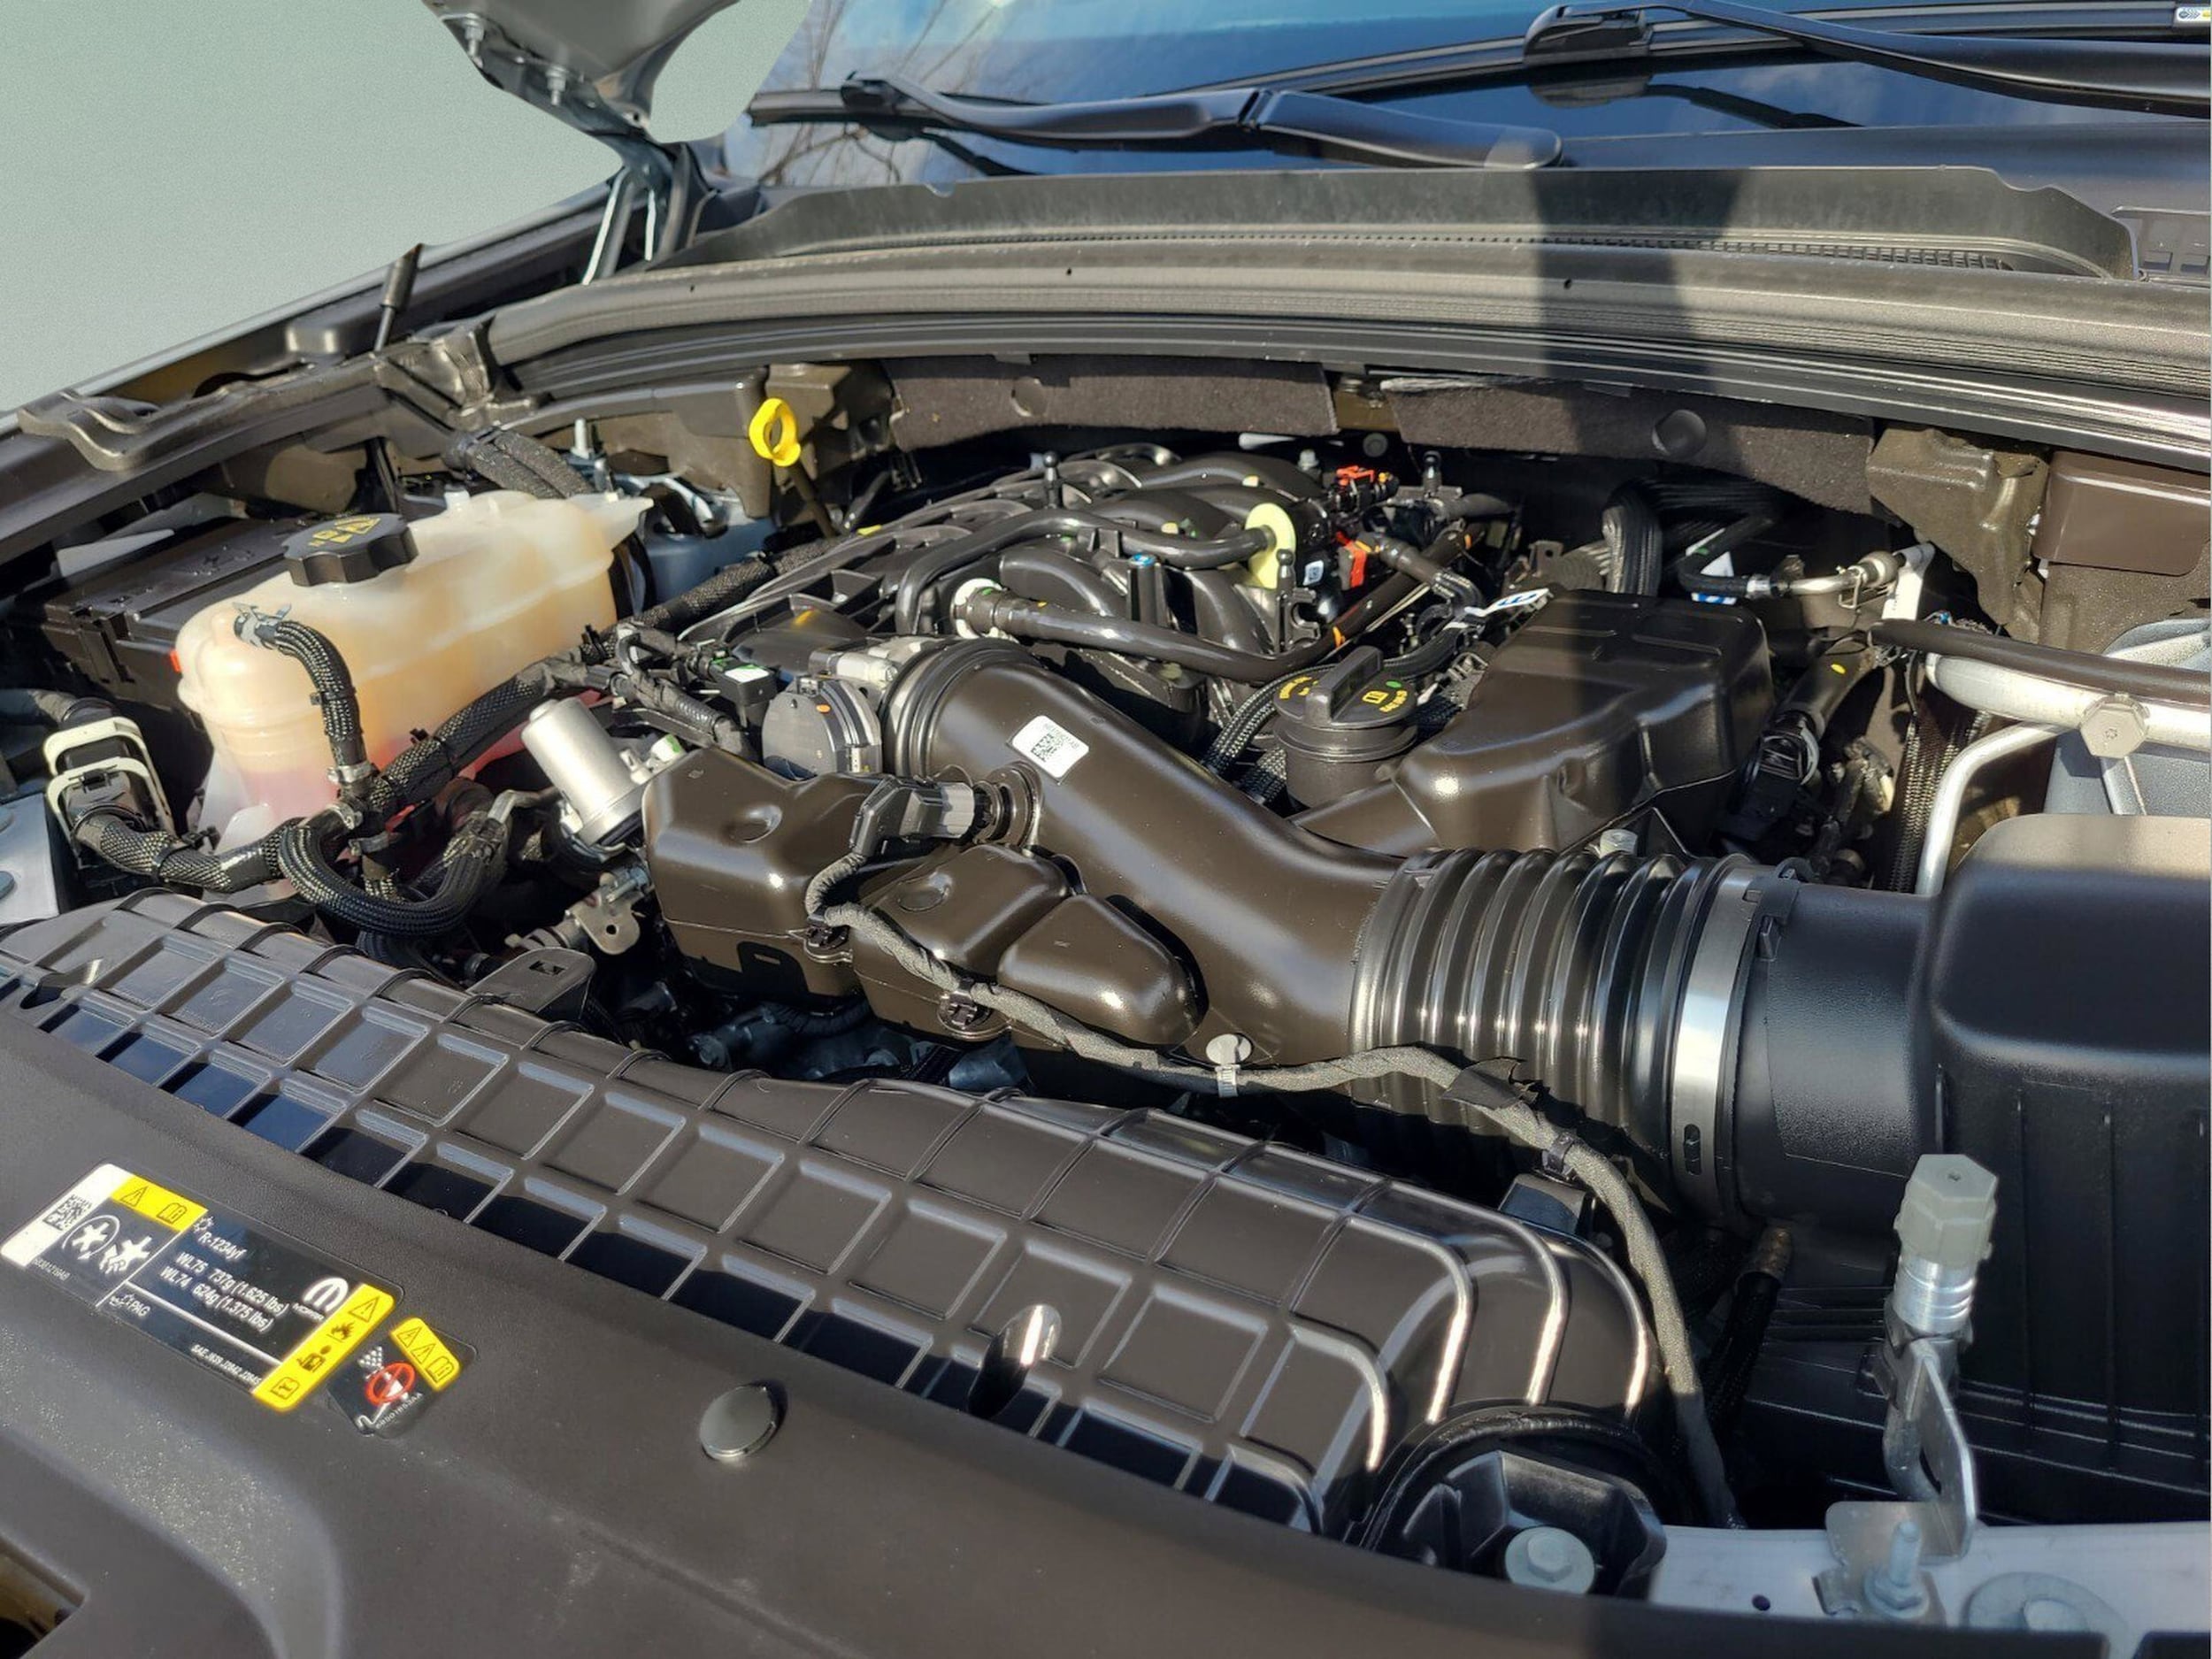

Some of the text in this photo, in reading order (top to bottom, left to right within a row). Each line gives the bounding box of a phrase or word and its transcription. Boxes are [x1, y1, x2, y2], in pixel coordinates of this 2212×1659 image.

[197, 1231, 248, 1260] R-1234yf
[159, 1265, 274, 1333] WL74 624g (1.375 lbs)
[175, 1251, 290, 1317] WL75 737g (1.625 lbs)
[128, 1298, 151, 1318] PAG
